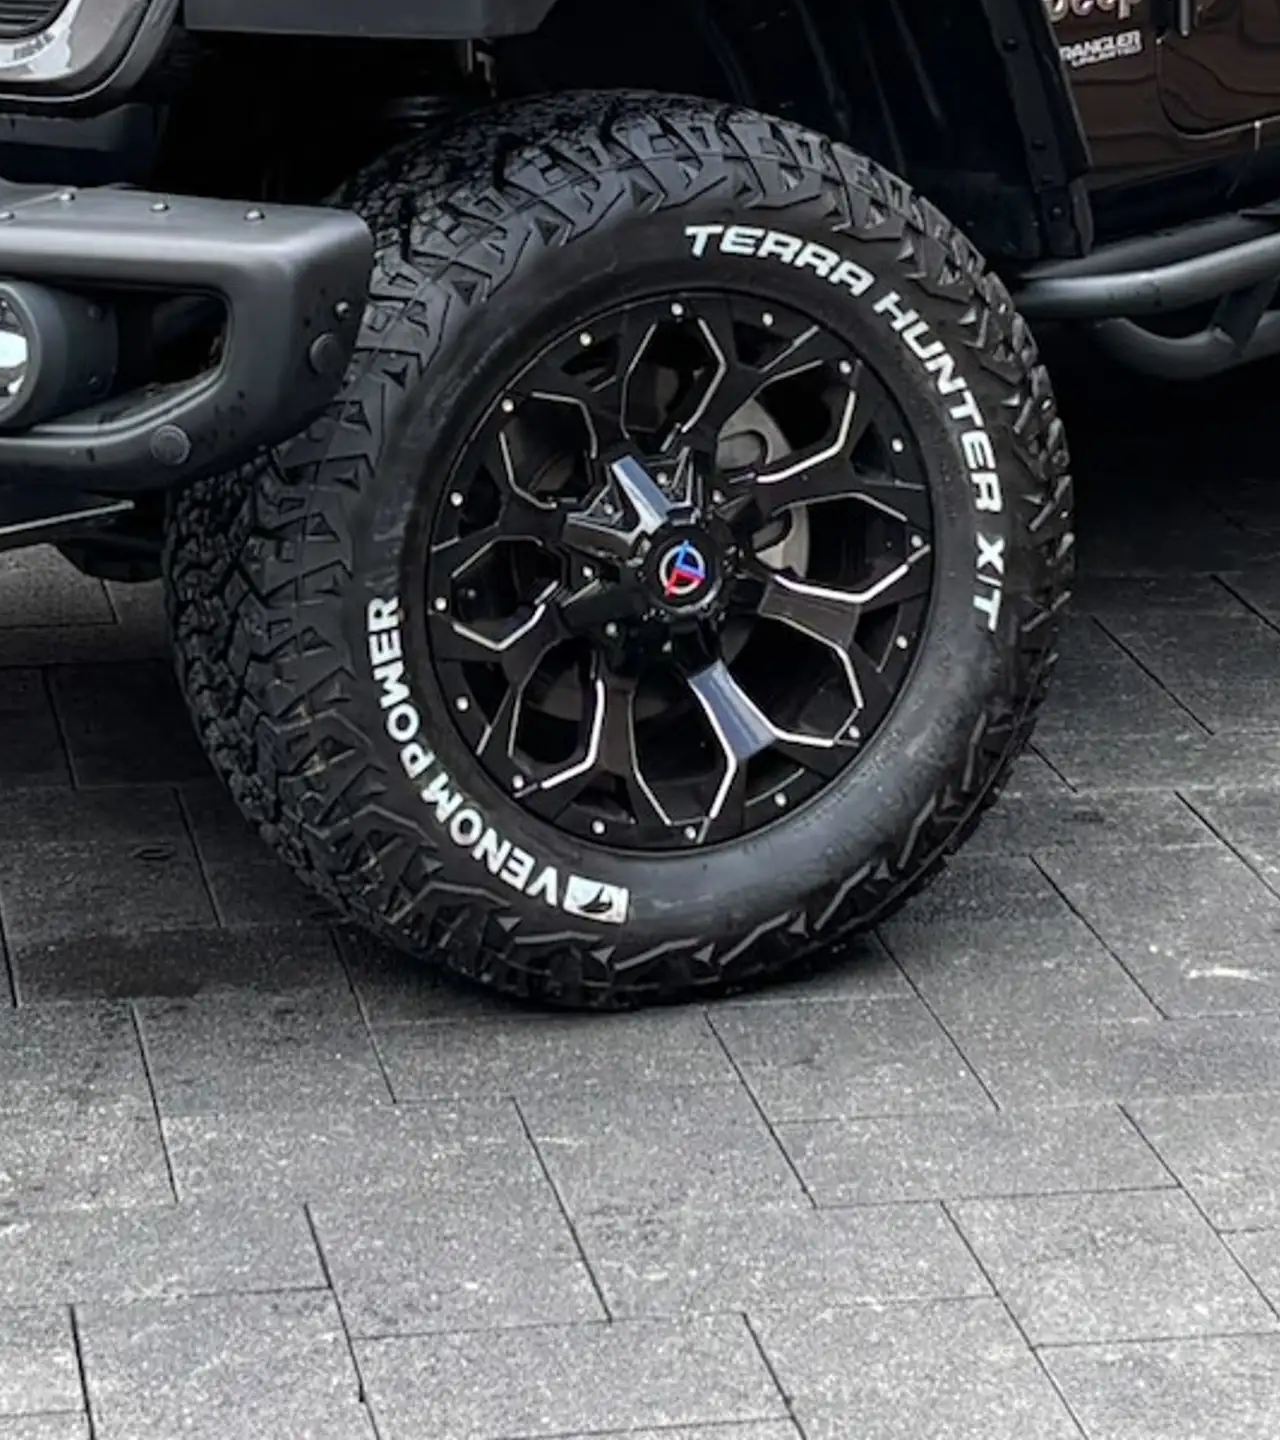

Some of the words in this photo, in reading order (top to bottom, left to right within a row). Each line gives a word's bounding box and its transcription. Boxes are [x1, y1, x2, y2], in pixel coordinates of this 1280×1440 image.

[1059, 30, 1143, 61] RANGLER
[684, 224, 876, 298] TERRA
[872, 290, 1003, 514] HUNTER
[972, 530, 1005, 633] X/T
[366, 595, 436, 780] POWER
[421, 772, 560, 907] VENOM
